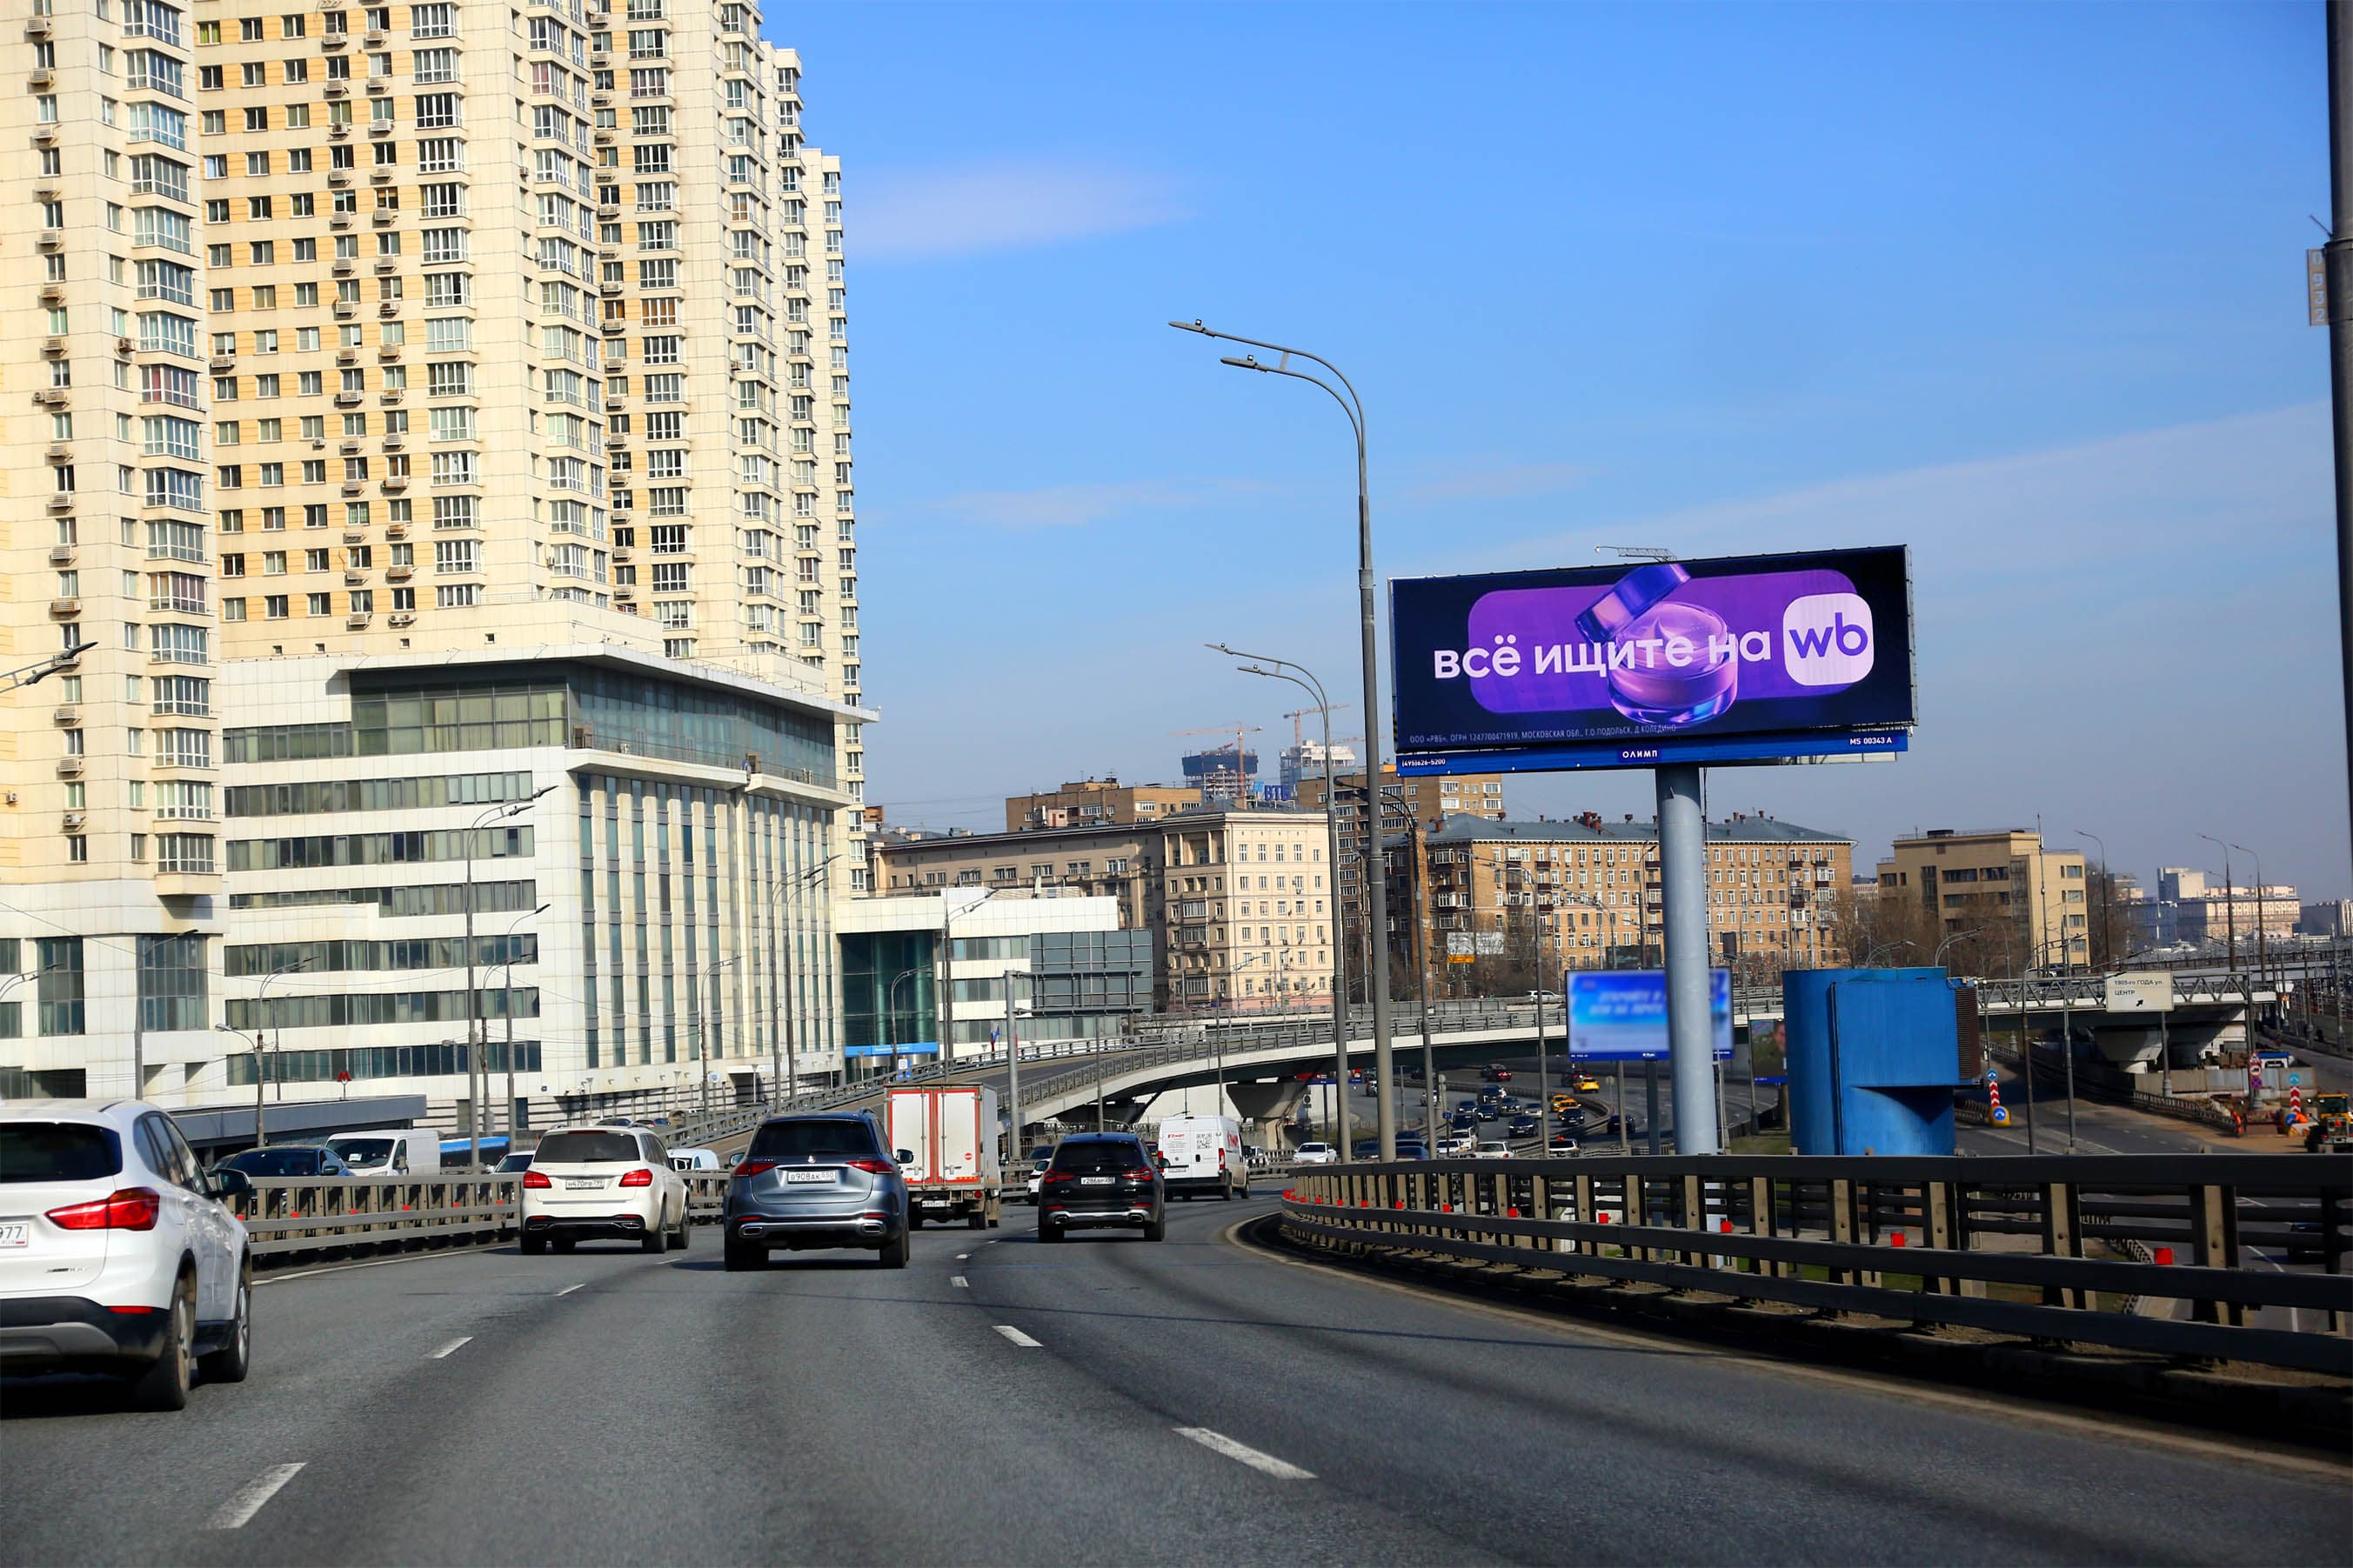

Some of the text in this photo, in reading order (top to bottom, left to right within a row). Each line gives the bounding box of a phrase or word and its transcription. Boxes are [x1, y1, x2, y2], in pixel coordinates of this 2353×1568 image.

[1434, 612, 1868, 678] всё ищите на wb
[1409, 735, 1425, 744] ООО
[1450, 733, 1467, 742] ОГРН
[1522, 730, 1565, 738] МОСКОВСКАЯ
[1641, 724, 1676, 734] КОЛЕДИНО
[1622, 750, 1658, 758] ОЛИМП
[1401, 758, 1446, 767] (495)626-5200
